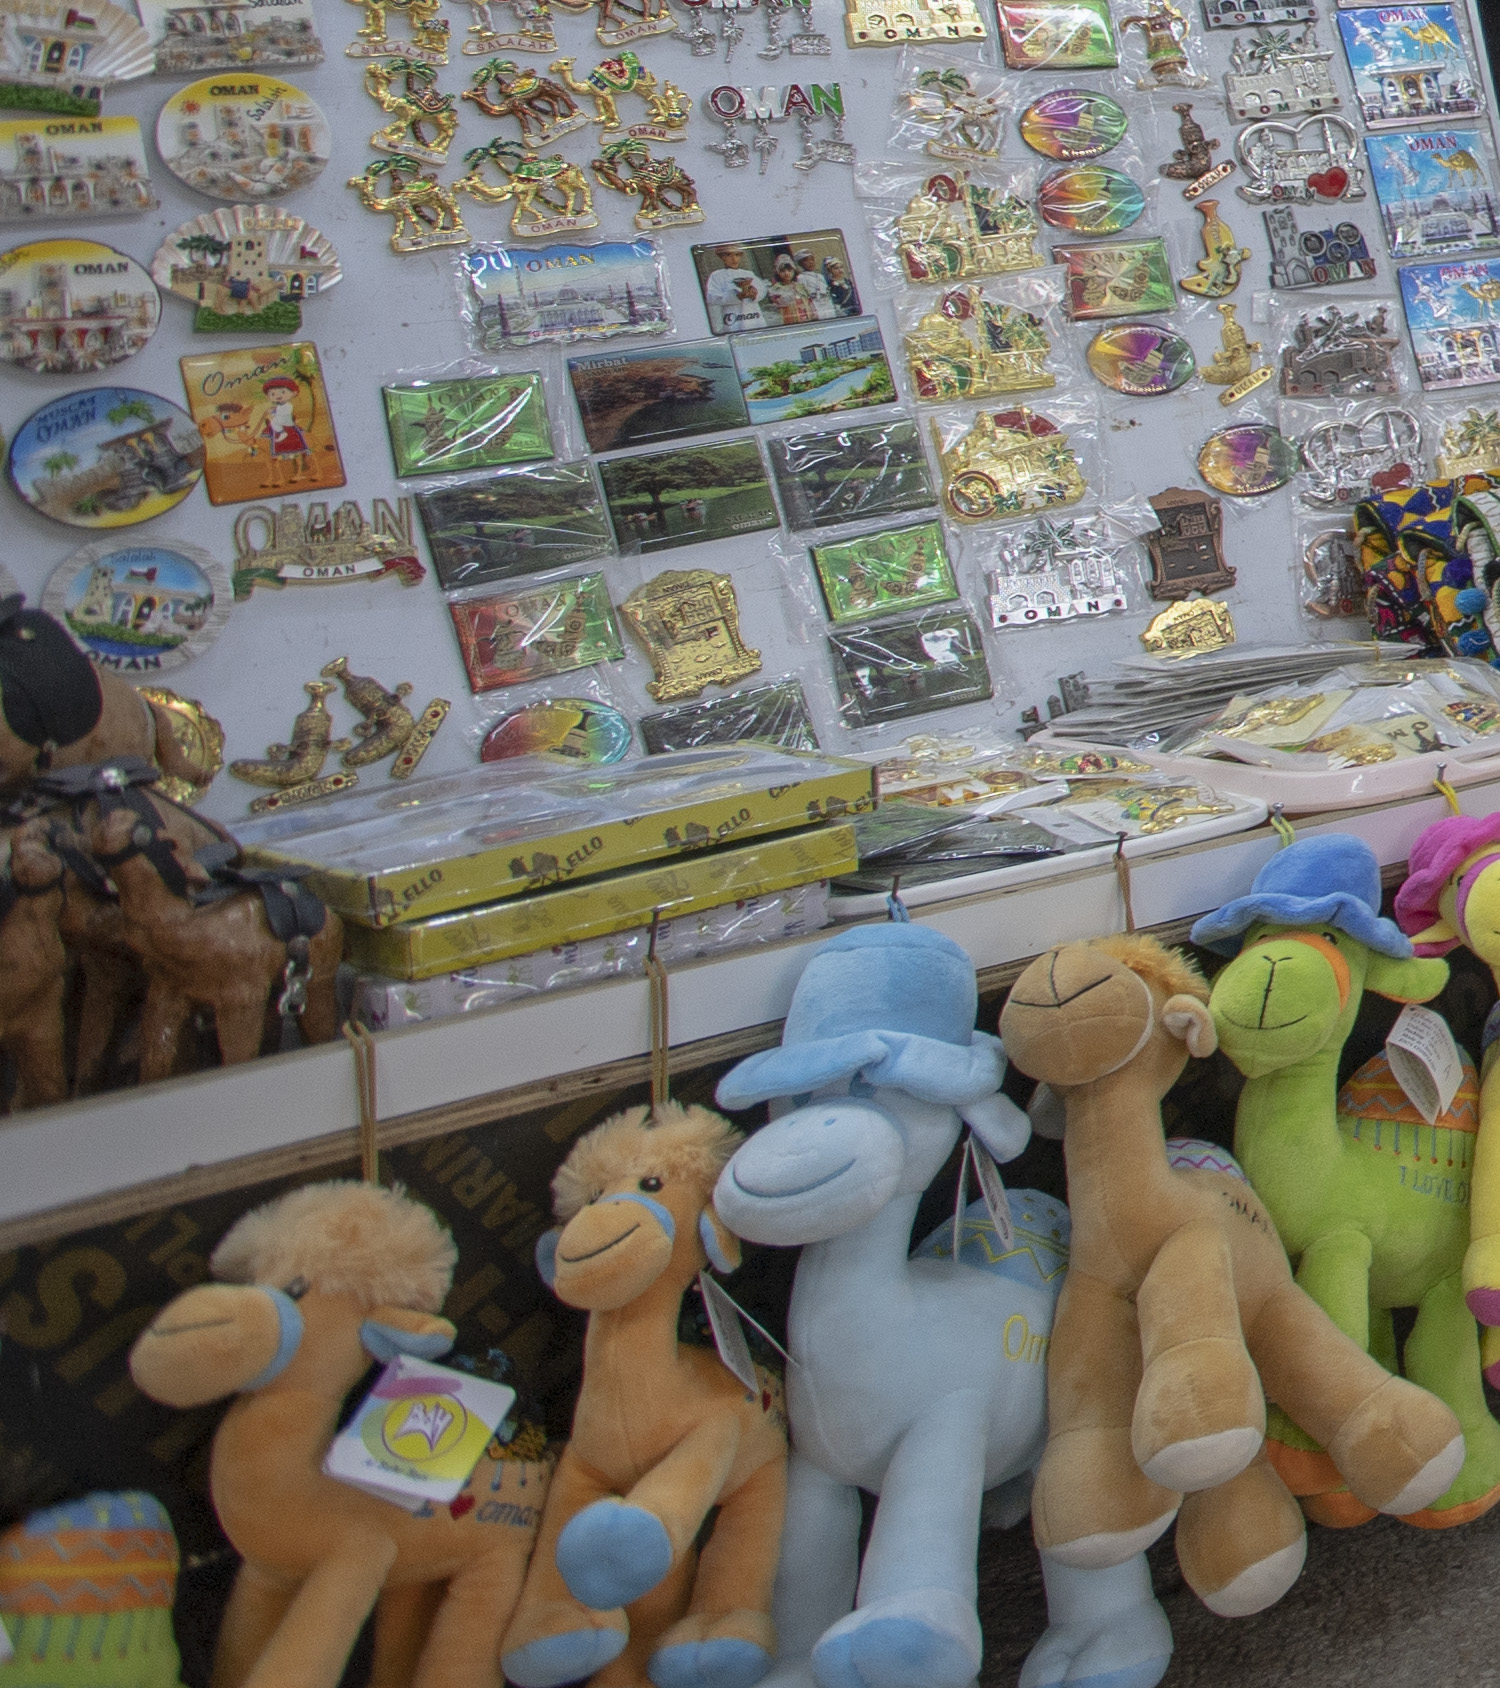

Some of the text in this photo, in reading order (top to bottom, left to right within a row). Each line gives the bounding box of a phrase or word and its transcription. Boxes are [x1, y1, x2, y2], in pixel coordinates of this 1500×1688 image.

[1378, 7, 1427, 24] OMAN
[615, 22, 658, 41] OMAN
[885, 25, 960, 40] OMAN
[361, 44, 438, 63] SALALAH
[476, 40, 549, 53] SALALAH
[209, 84, 260, 97] OMAN
[246, 86, 289, 123] Salalah
[708, 83, 846, 119] OMAN
[45, 122, 103, 136] OMAN
[628, 125, 667, 138] OMAN
[1409, 135, 1458, 152] OMAN
[531, 216, 577, 234] OMAN
[75, 261, 129, 276] OMAN
[525, 253, 596, 274] OMAN
[1312, 258, 1376, 284] OMAN
[1439, 263, 1489, 280] OMAN
[577, 357, 630, 374] Mirbat
[202, 355, 293, 397] Oman
[36, 410, 98, 443] OMAN
[303, 564, 357, 578] OMAN
